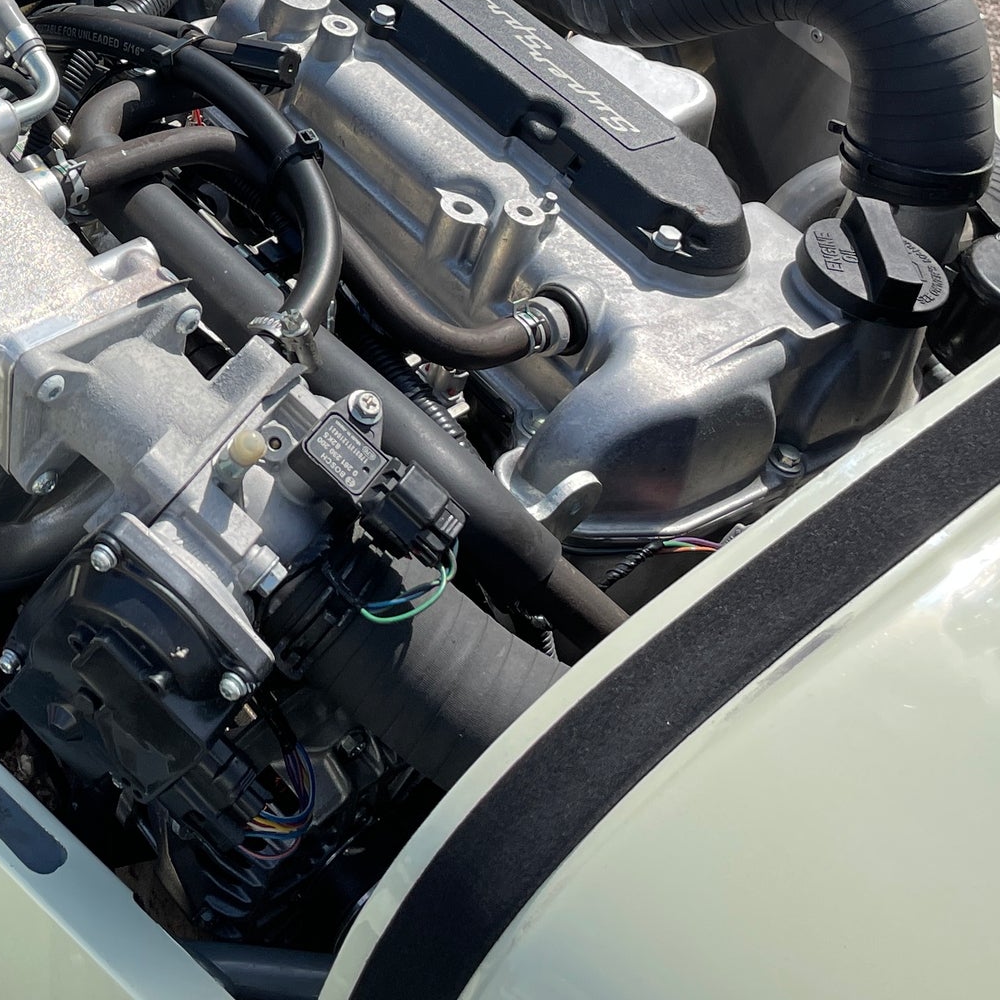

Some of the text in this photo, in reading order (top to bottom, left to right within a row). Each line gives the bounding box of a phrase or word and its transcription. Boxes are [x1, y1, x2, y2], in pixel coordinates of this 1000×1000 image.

[63, 26, 76, 38] FOR
[78, 30, 120, 49] UNLEADED
[813, 231, 844, 273] ENGINE
[316, 437, 329, 450] 200
[320, 452, 346, 478] BOSCH
